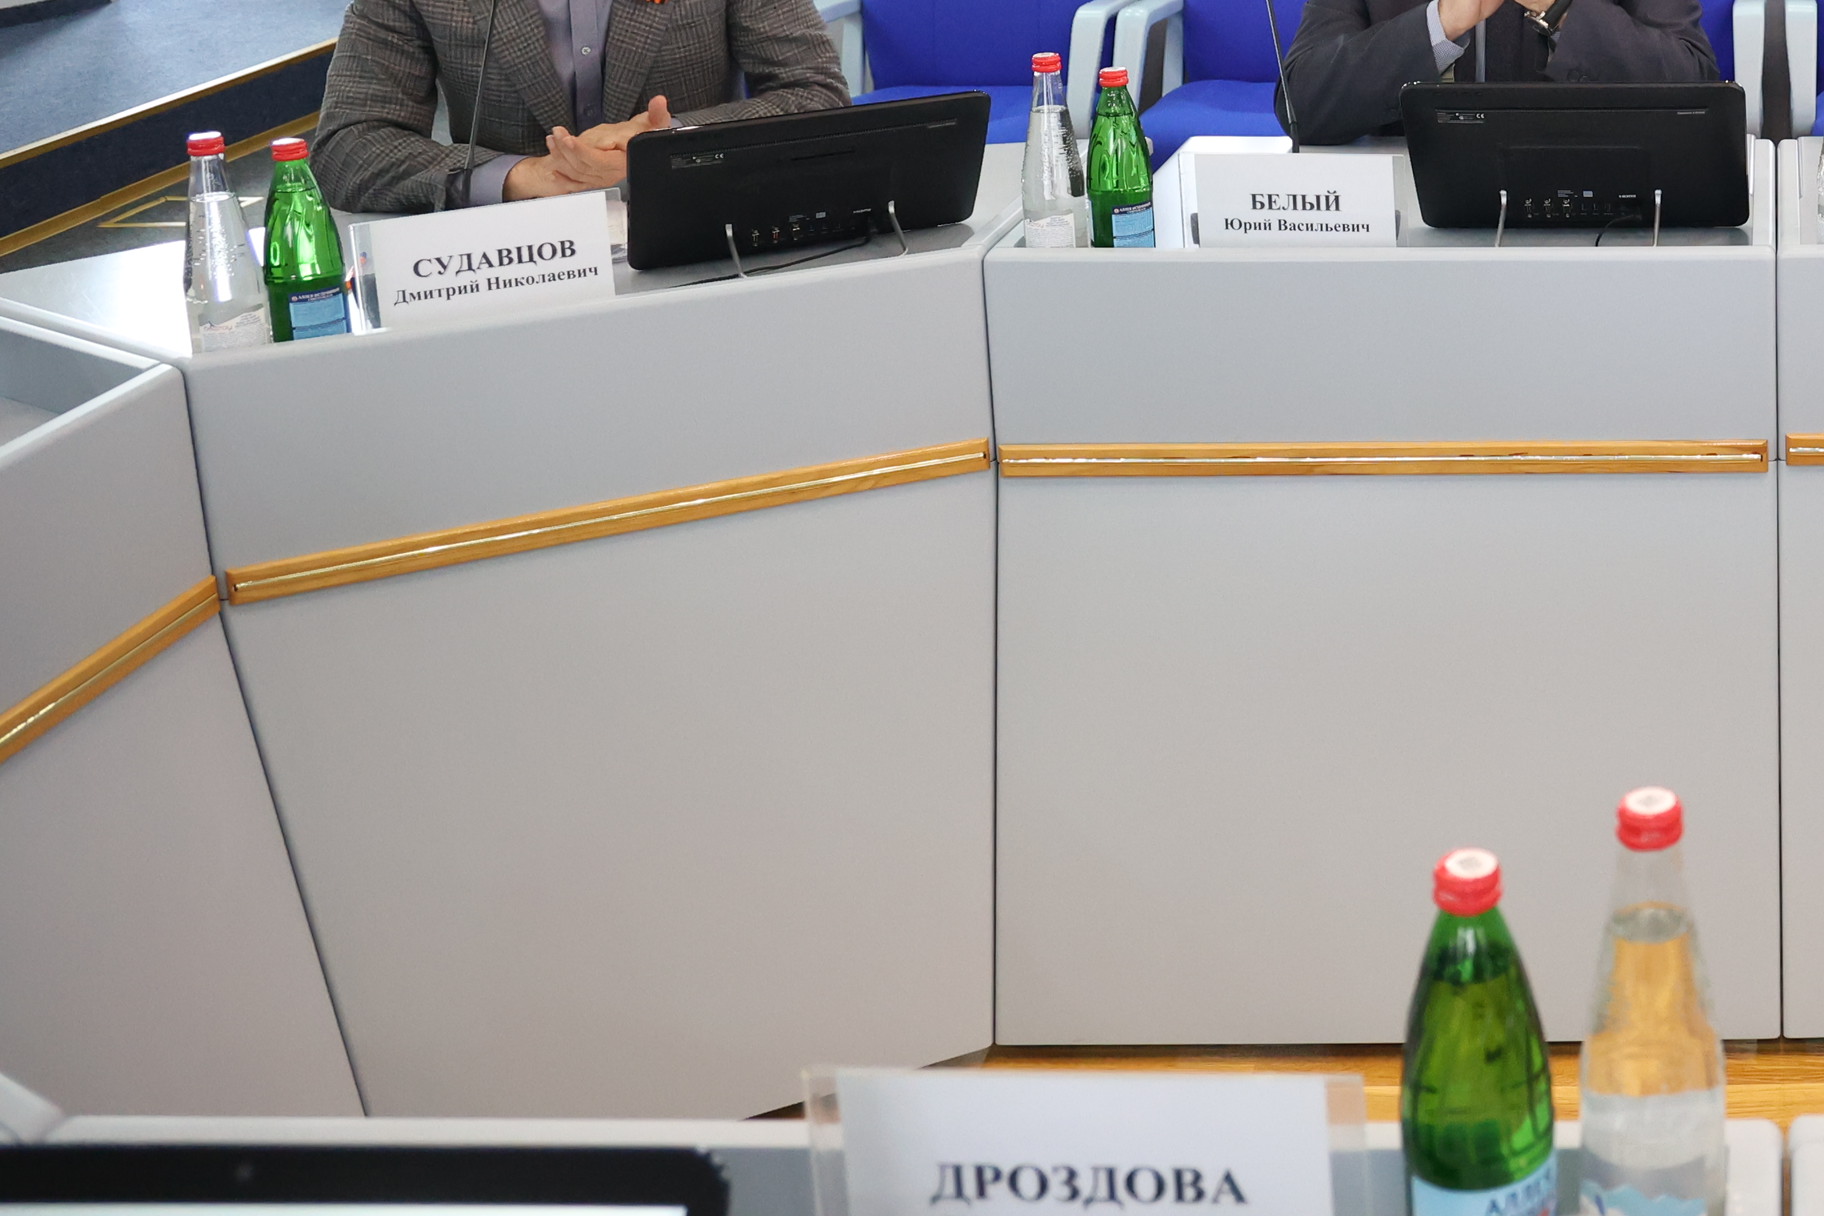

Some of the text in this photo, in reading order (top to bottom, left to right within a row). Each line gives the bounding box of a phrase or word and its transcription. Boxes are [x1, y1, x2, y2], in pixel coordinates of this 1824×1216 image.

[1250, 190, 1342, 212] БЕЛЫЙ
[1224, 218, 1370, 234] Юрий Васильевич
[413, 240, 577, 278] СУДАВЦОВ
[394, 266, 599, 306] Дмитрий Николаевич
[929, 1163, 1248, 1210] ДРОЗДОВА
